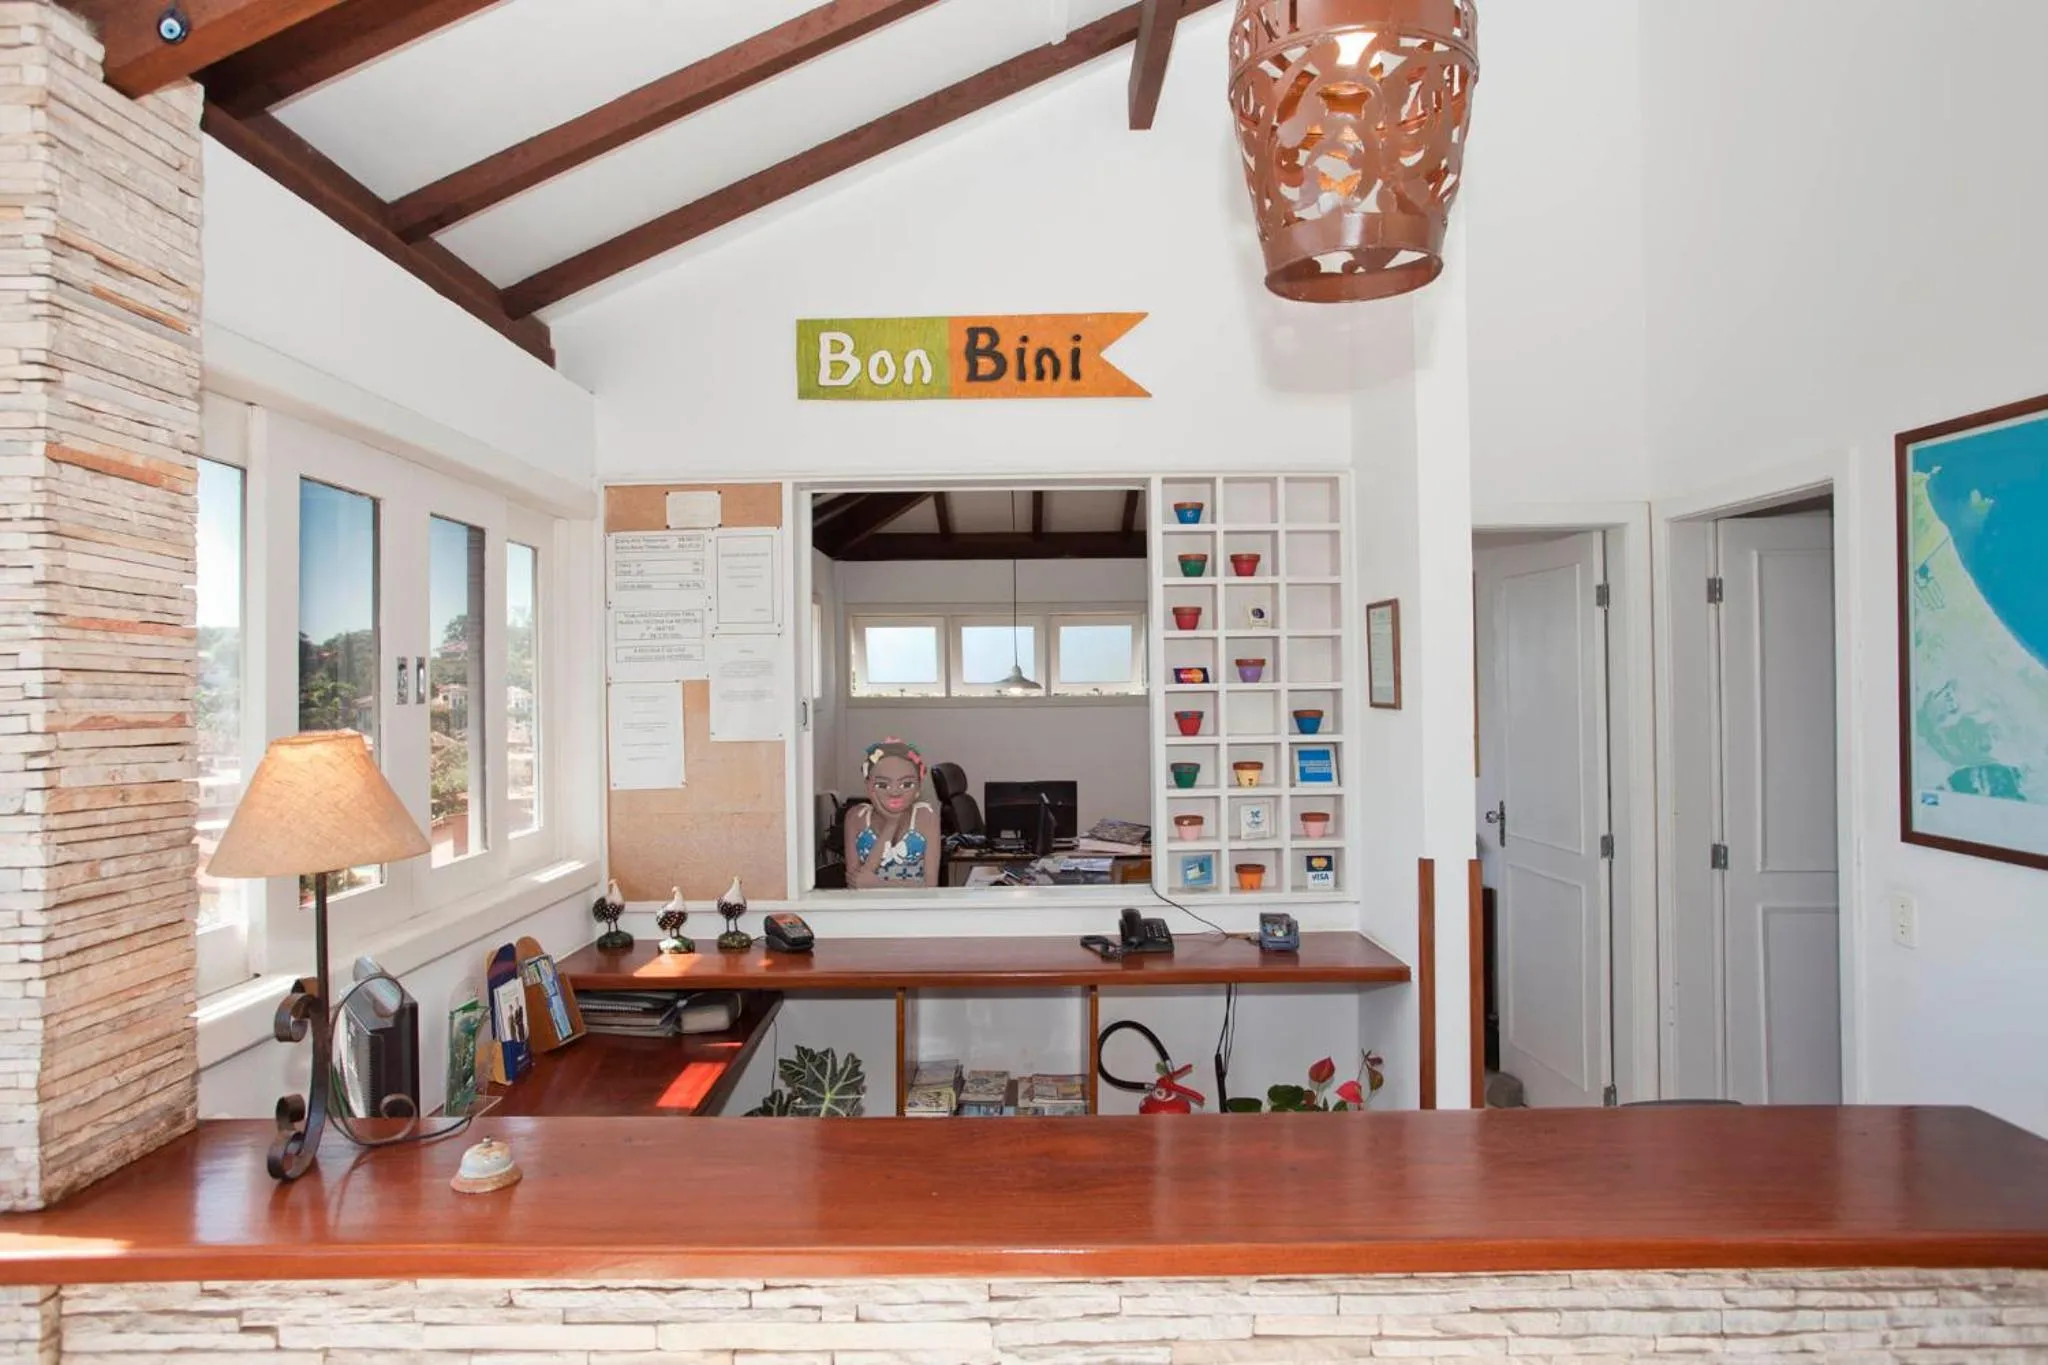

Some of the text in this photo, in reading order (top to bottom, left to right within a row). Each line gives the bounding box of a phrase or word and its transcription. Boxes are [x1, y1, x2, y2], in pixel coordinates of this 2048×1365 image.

[818, 327, 1082, 386] Bon Bini
[1312, 872, 1329, 881] VISA
